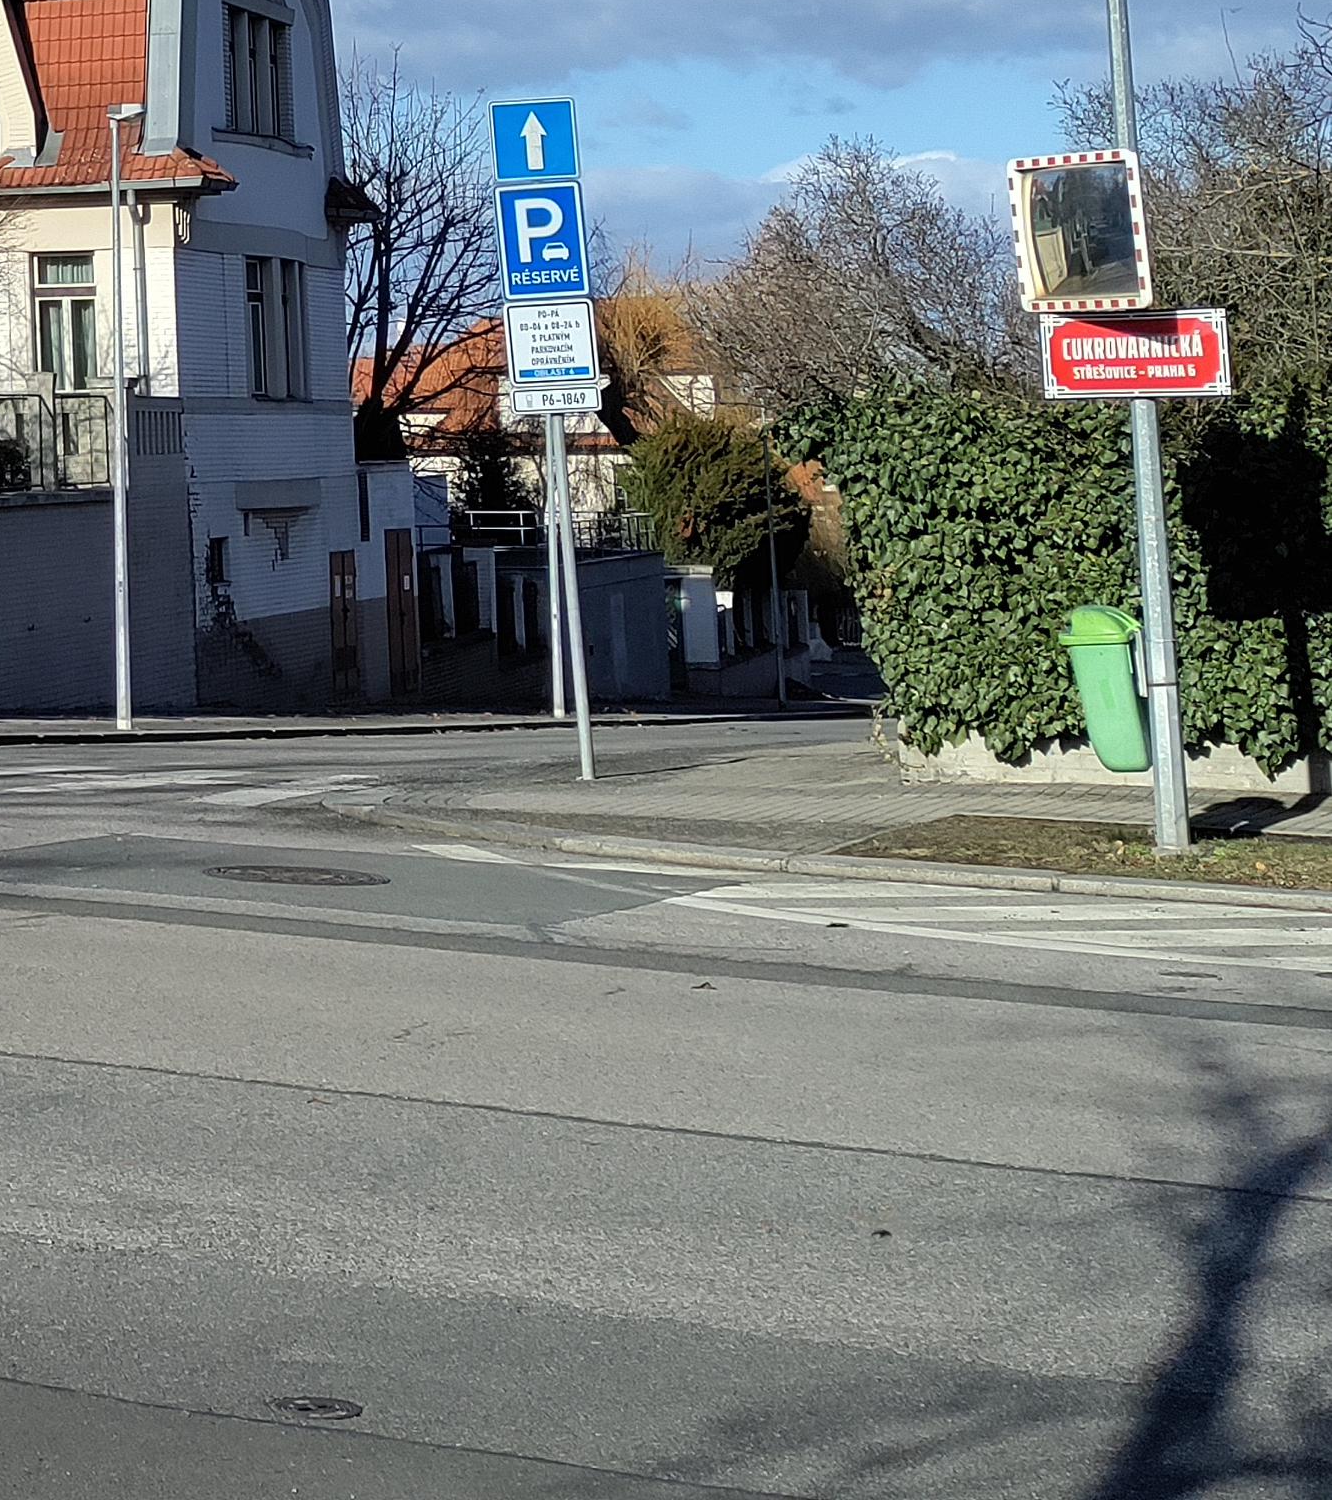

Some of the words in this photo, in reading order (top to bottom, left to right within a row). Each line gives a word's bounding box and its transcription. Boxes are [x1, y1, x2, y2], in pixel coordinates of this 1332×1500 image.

[514, 197, 564, 263] P
[511, 265, 581, 286] RÉSERVÉ
[1062, 329, 1204, 361] CUKROVARNICKÁ
[1072, 363, 1137, 381] STŘEŠOVICE
[1147, 364, 1186, 379] PRAHA
[1188, 363, 1197, 378] 6
[541, 392, 586, 407] P6-1849
